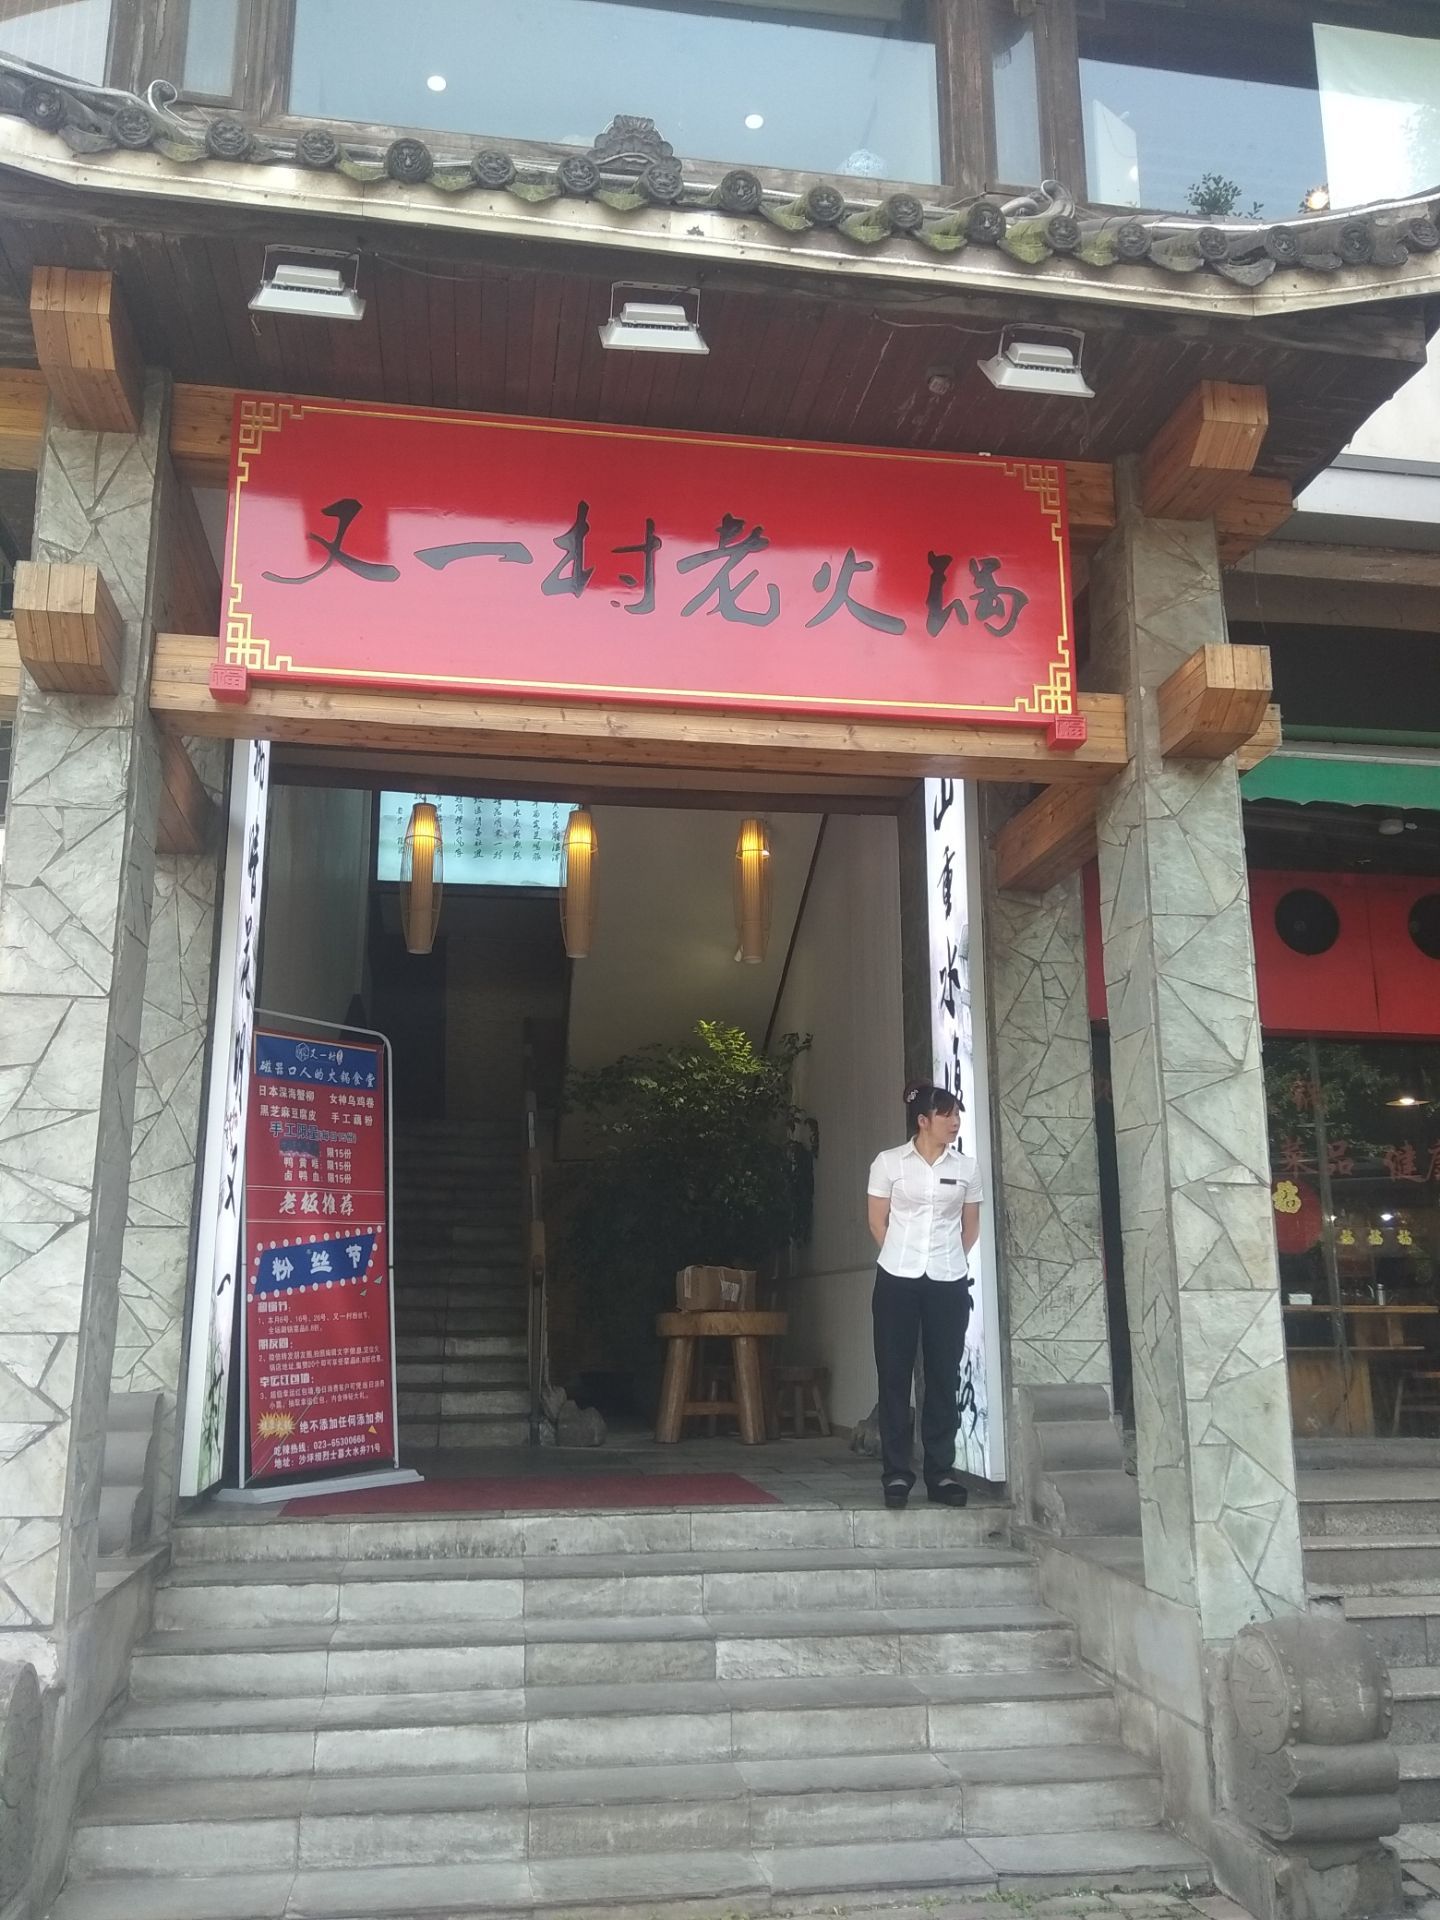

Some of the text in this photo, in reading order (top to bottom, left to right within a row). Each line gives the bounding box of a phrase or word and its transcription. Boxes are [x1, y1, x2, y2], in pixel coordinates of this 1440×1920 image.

[262, 498, 1029, 638] 又一村老火锅
[260, 1104, 317, 1121] 黑芝麻豆腐皮
[279, 1191, 355, 1217] 老板推荐
[271, 1244, 362, 1282] 粉丝节
[299, 1410, 384, 1434] 绝不添加任何添加剂
